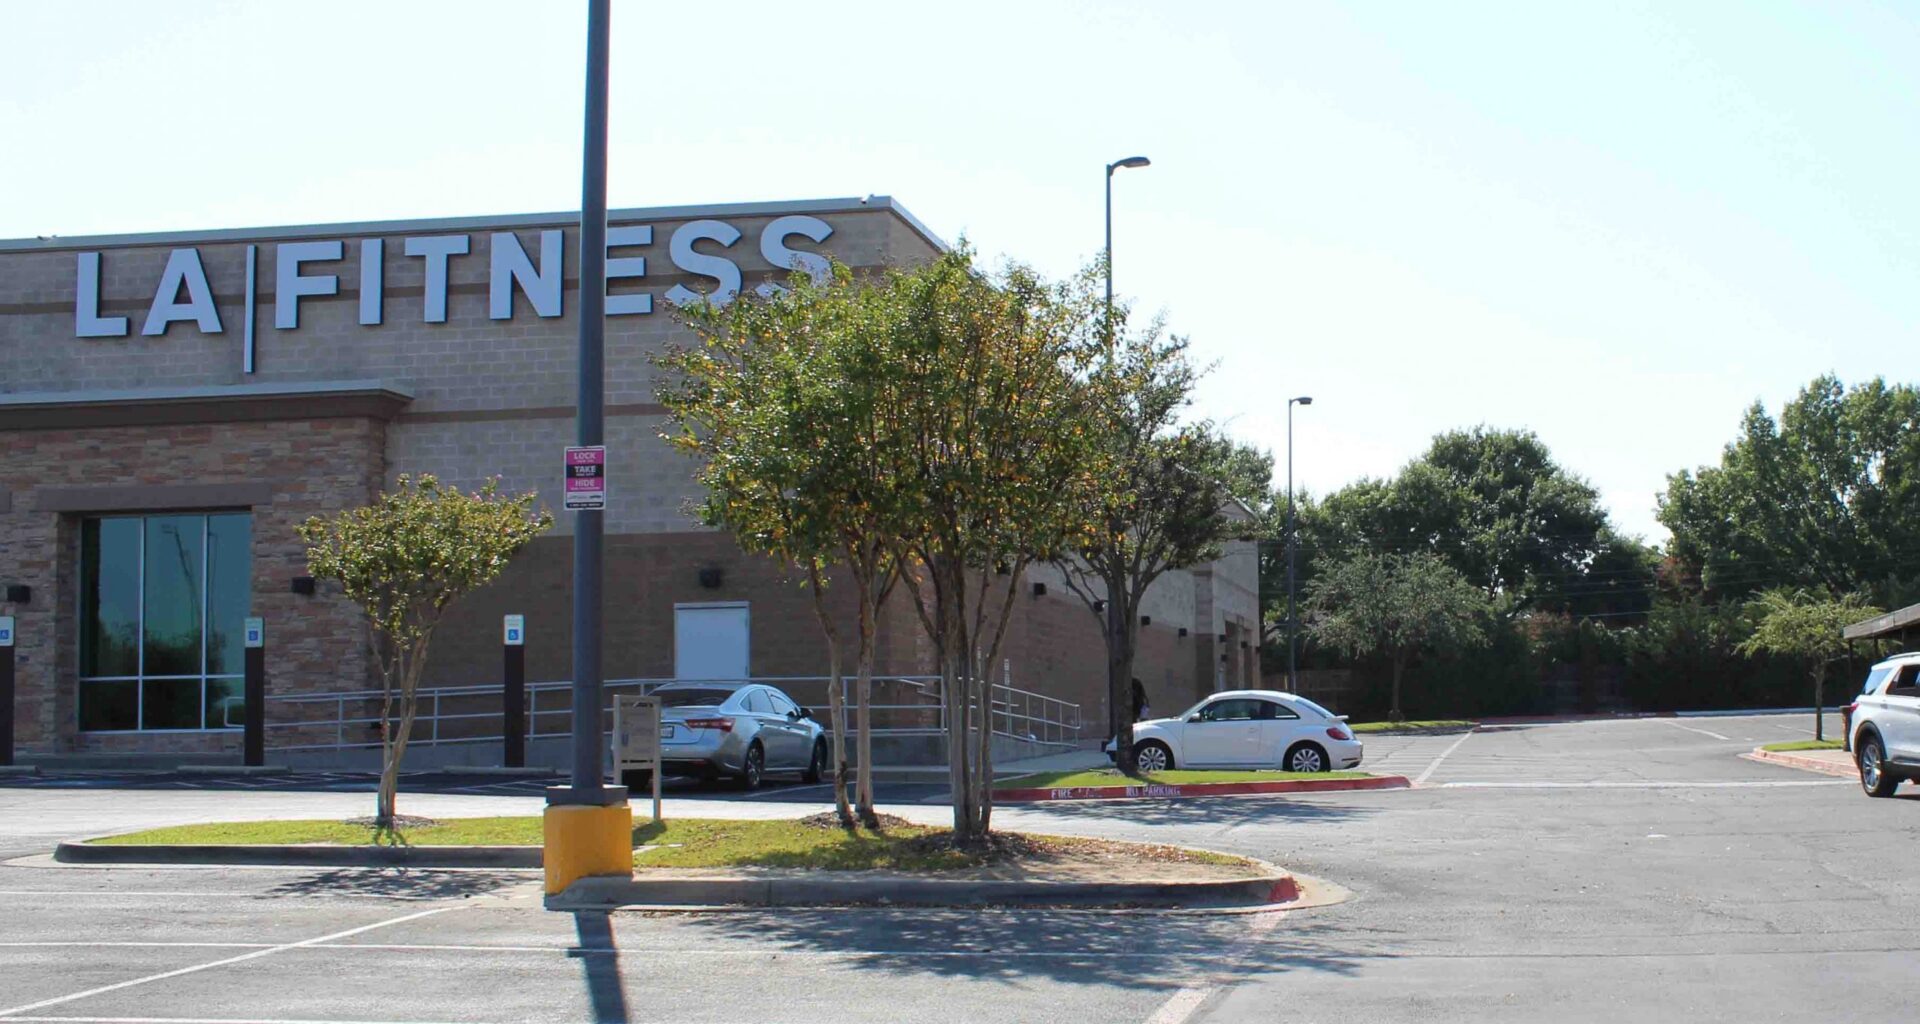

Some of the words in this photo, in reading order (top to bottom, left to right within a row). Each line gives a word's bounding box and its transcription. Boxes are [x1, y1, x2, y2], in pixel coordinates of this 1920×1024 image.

[75, 247, 224, 338] LA
[275, 214, 834, 330] FITNESS
[573, 452, 597, 460] LOCK
[574, 465, 596, 473] TAKE
[575, 479, 595, 487] HIDE
[1051, 788, 1073, 798] FIRE
[1126, 786, 1138, 797] NO
[1143, 784, 1181, 797] PARKING
